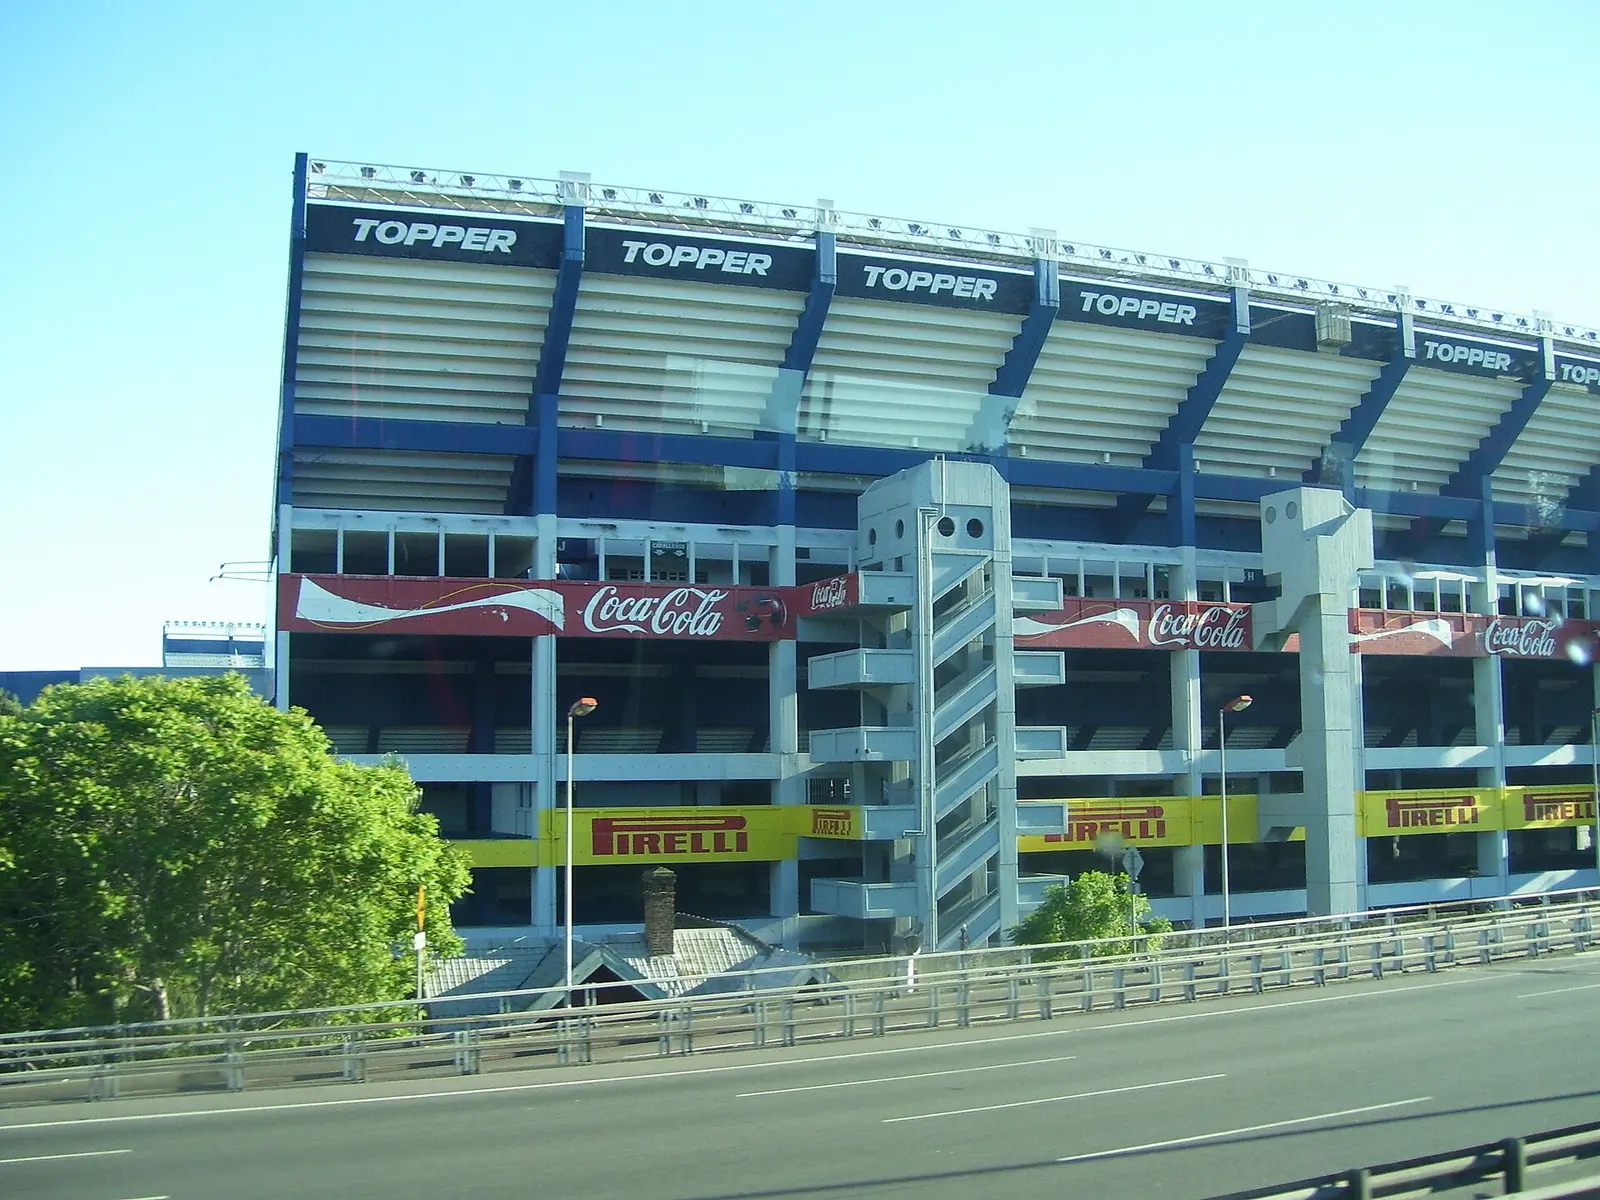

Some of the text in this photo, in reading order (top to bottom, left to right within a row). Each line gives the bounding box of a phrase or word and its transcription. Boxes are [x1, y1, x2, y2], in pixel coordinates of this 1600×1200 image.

[352, 217, 517, 254] TOPPER
[621, 240, 773, 277] TOPPER
[862, 265, 998, 301] TOPPER
[1079, 291, 1197, 326] TOPPER
[1424, 341, 1511, 371] TOPPER
[1560, 363, 1600, 386] TOP
[583, 586, 729, 636] Coca-Cola
[1148, 603, 1249, 648] Coca-Cola
[1484, 619, 1556, 657] Coca-Cola
[1386, 795, 1478, 828] PIRELLI
[1523, 791, 1597, 821] PIRELL
[592, 815, 748, 856] PIRELLI
